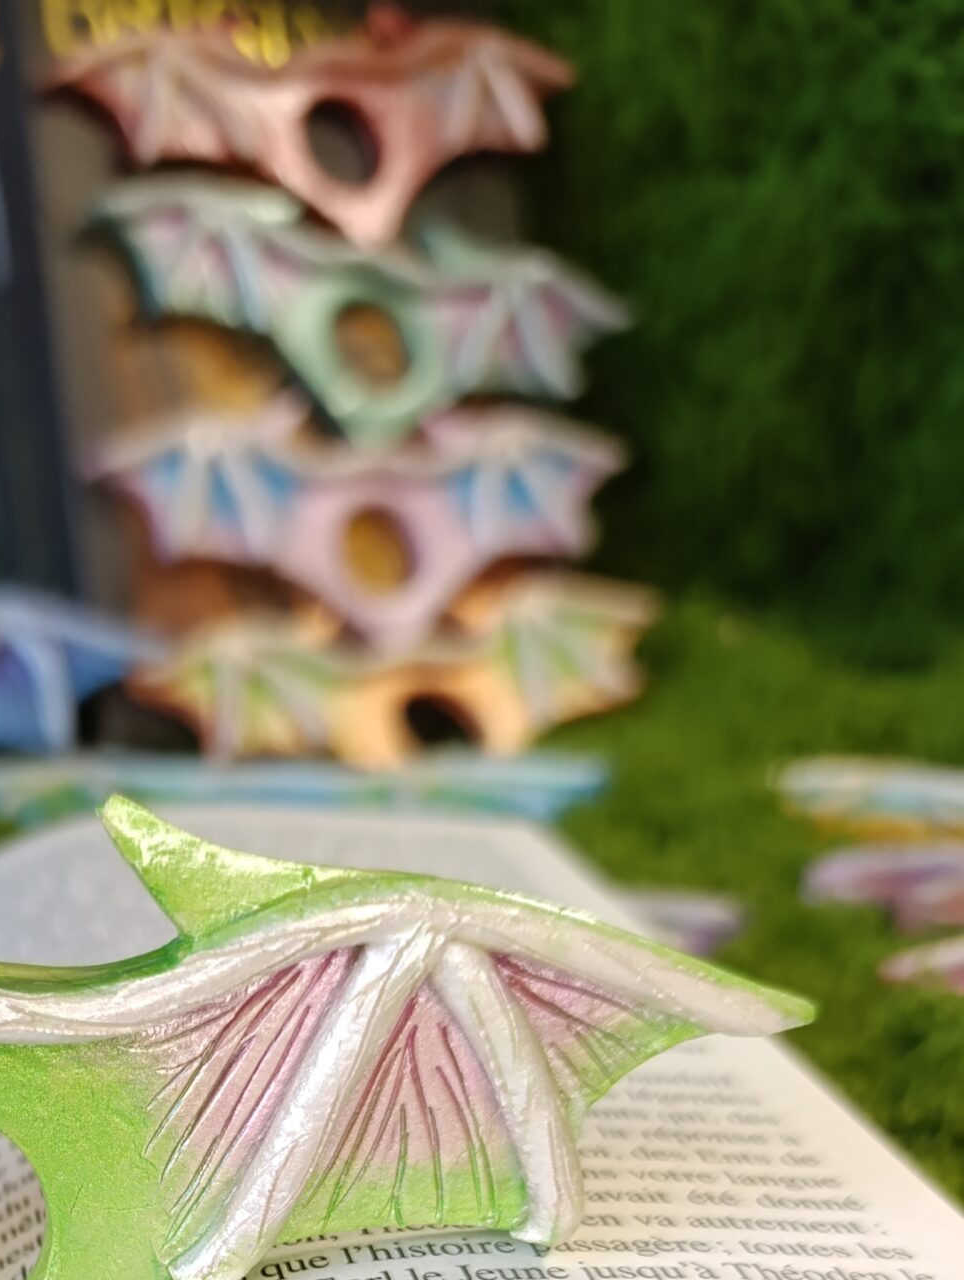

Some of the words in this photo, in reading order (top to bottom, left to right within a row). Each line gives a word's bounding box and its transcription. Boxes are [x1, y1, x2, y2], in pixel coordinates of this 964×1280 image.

[629, 1168, 718, 1184] votre
[723, 1170, 842, 1191] langue
[585, 1186, 671, 1203] avait
[686, 1187, 742, 1206] été
[755, 1193, 867, 1212] donné
[580, 1213, 622, 1228] en
[633, 1213, 678, 1228] va
[686, 1214, 868, 1235] autrement
[259, 1255, 330, 1280] que
[738, 1240, 852, 1259] toutes
[855, 1242, 916, 1261] les
